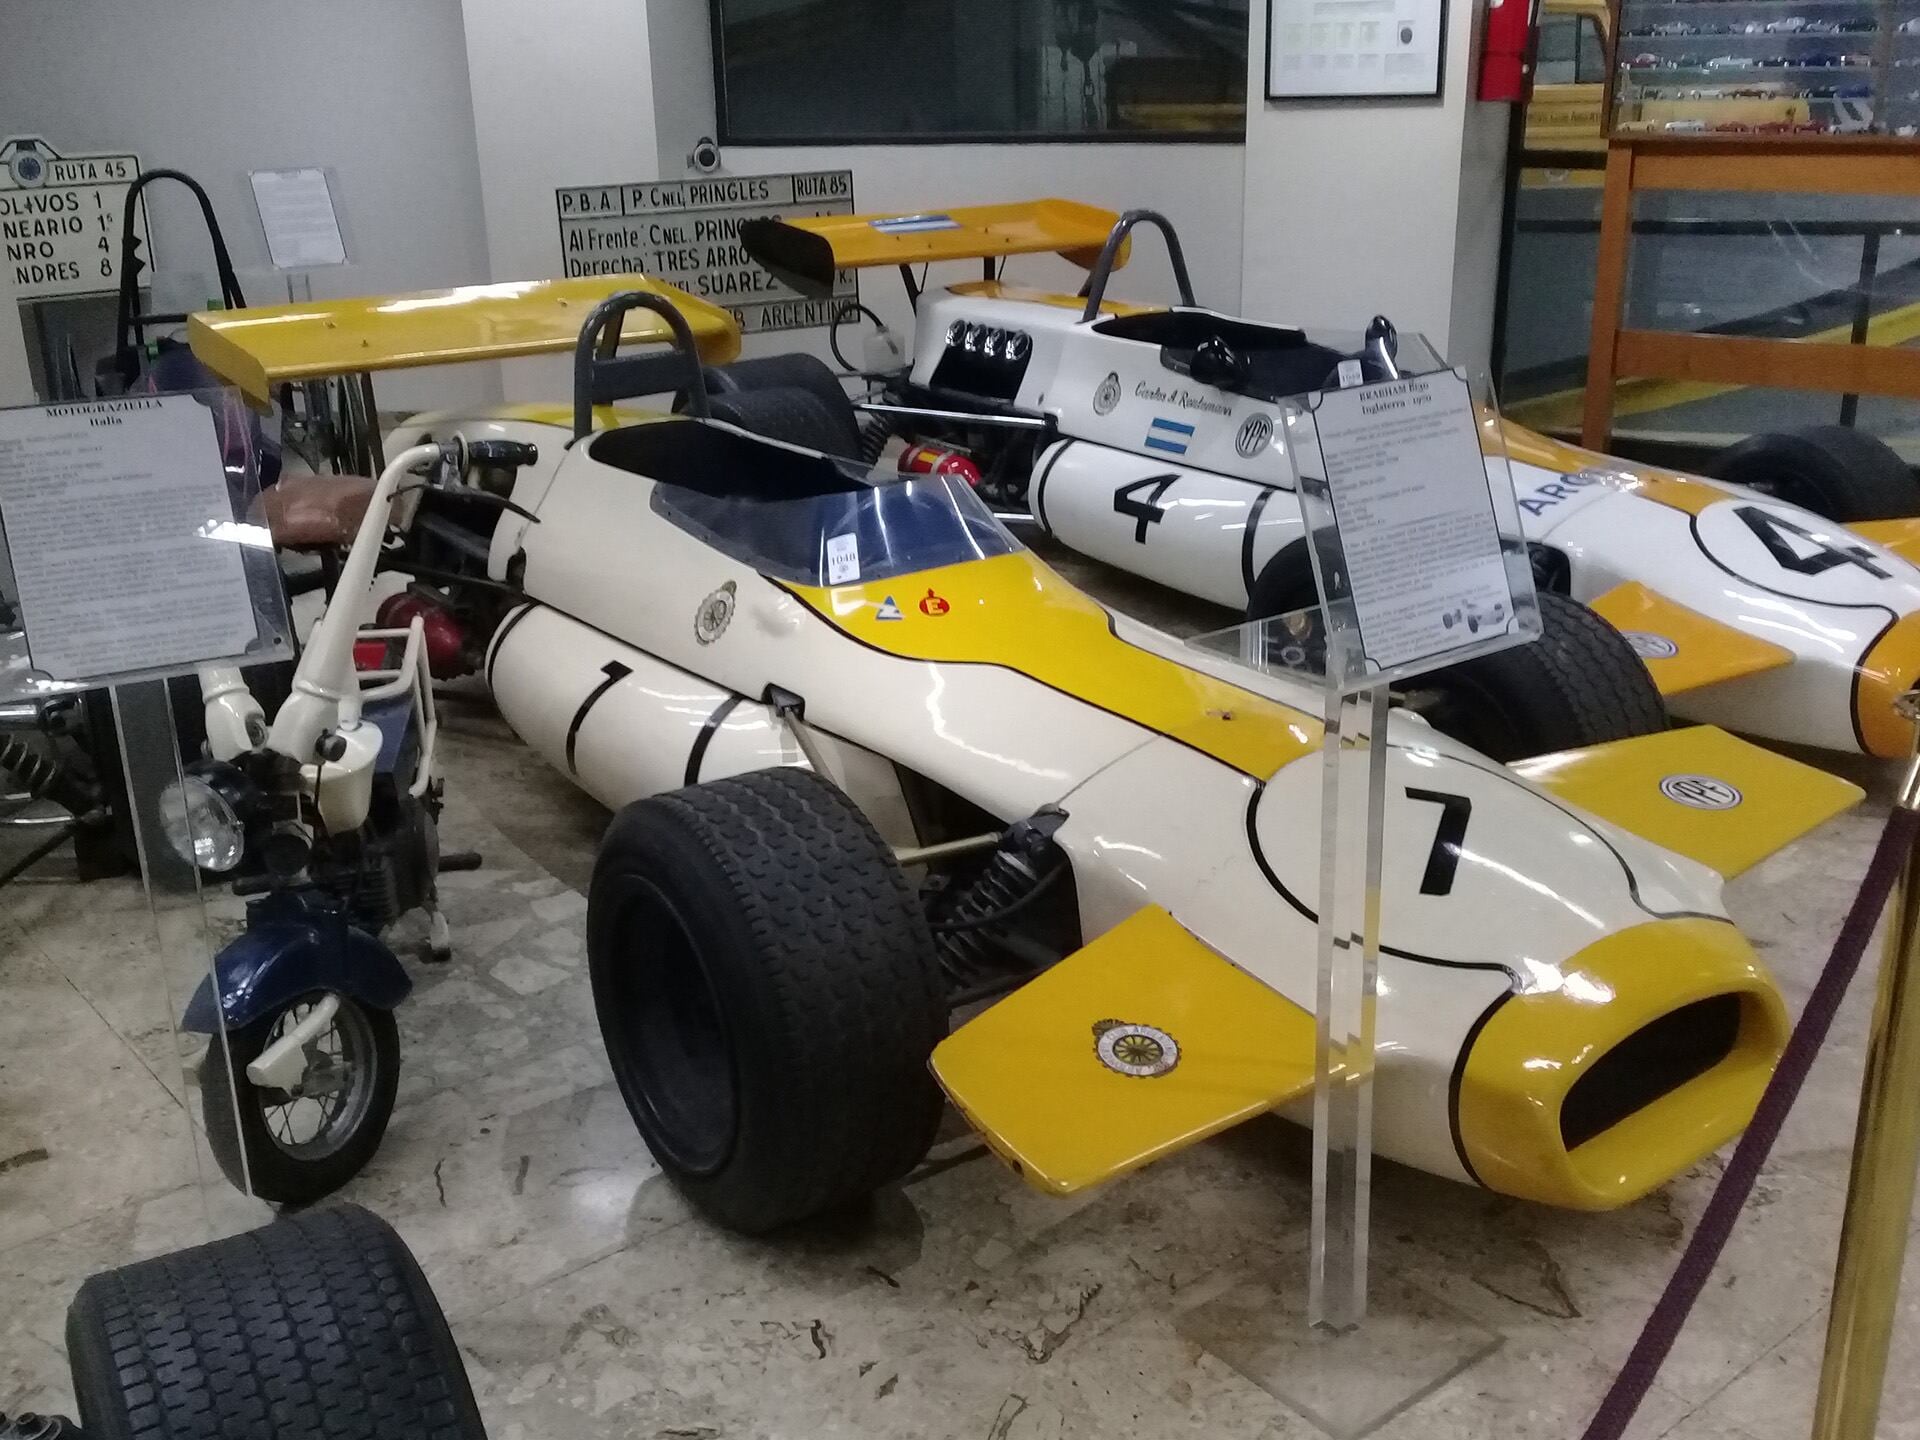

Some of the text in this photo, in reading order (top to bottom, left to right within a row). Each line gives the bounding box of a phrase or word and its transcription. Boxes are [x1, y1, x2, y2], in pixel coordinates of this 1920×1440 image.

[55, 161, 126, 181] RUTA 45
[93, 191, 102, 209] 1
[690, 181, 769, 204] PRINGLES
[797, 175, 827, 197] RUTA
[830, 174, 847, 195] 85
[6, 236, 109, 261] NRO 4
[653, 247, 700, 272] TRES
[100, 257, 113, 278] 8
[698, 268, 778, 297] SUAREZ
[90, 415, 122, 427] Italia
[1240, 418, 1270, 452] YPF
[1113, 472, 1183, 545] 4
[1732, 506, 1893, 581] 4
[1404, 786, 1473, 896] 7
